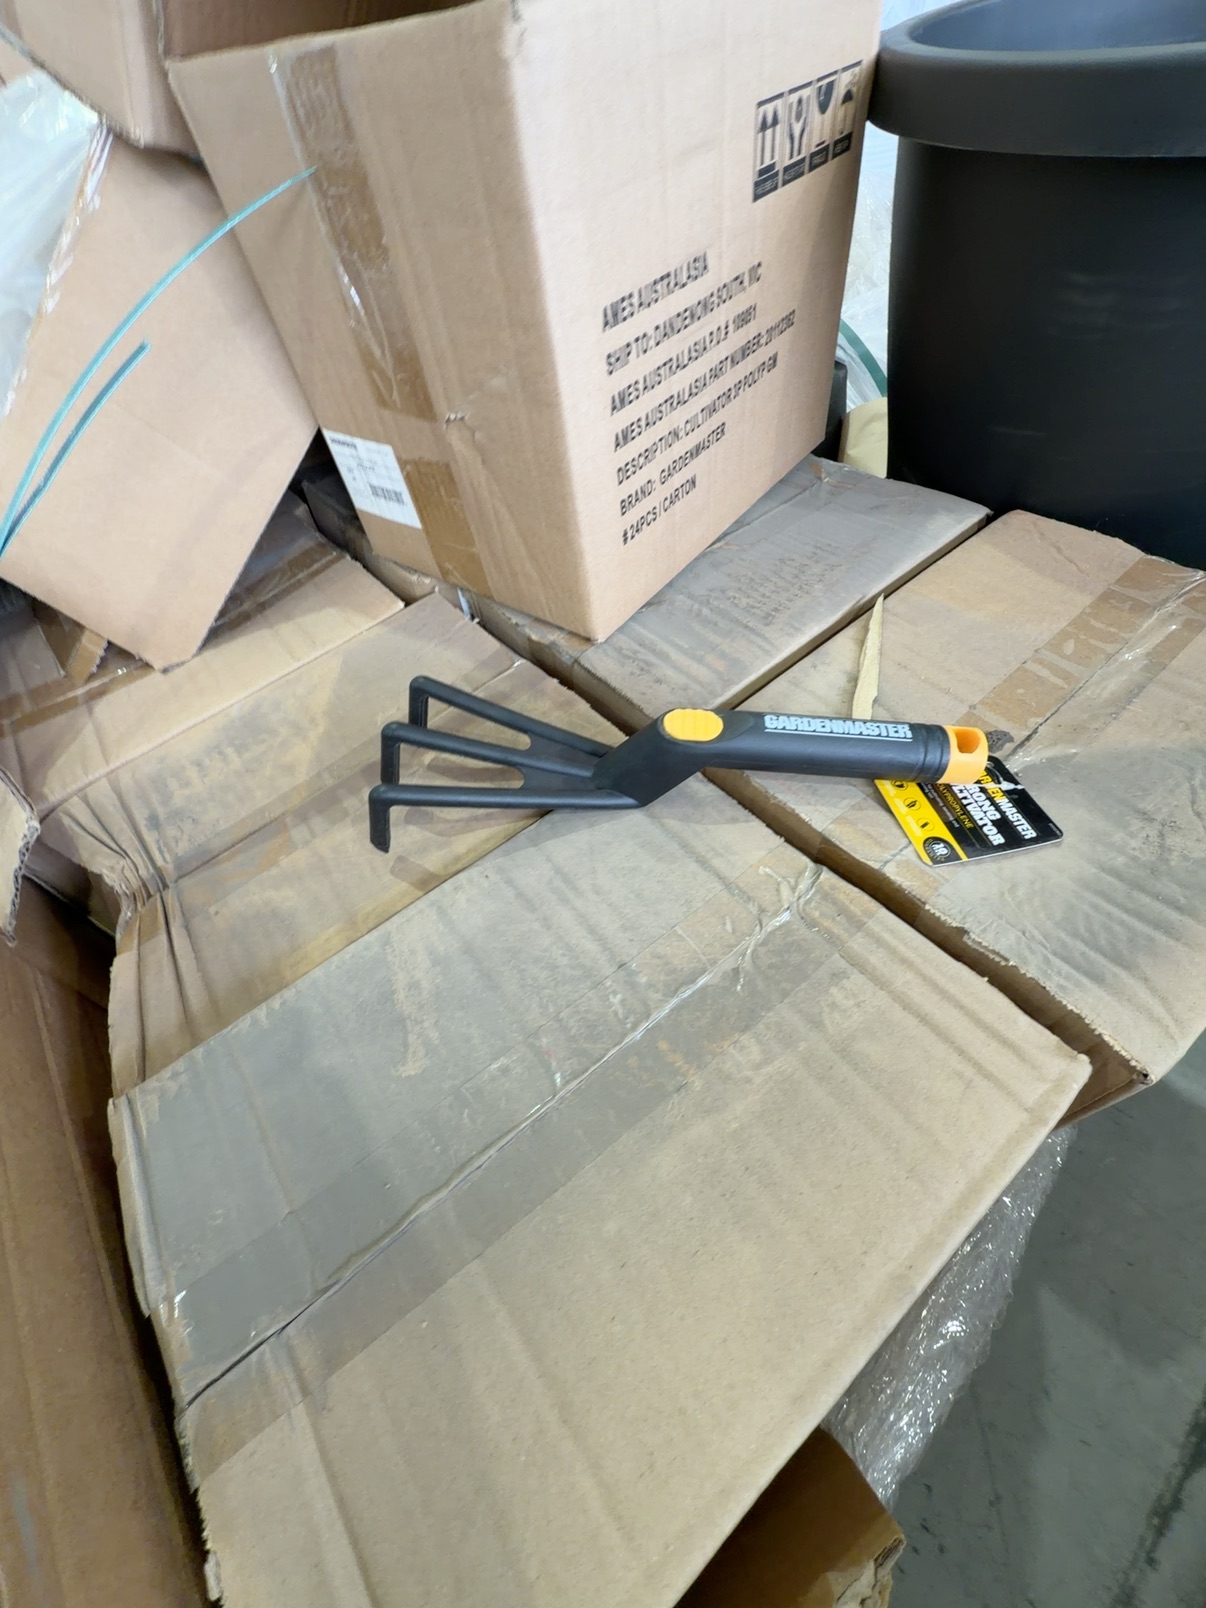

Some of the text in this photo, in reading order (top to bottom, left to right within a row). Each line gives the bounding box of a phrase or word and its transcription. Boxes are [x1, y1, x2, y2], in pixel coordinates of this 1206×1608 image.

[602, 251, 709, 333] AMES AUSTRALASIA
[606, 340, 632, 376] SHIP
[634, 331, 653, 359] TO:
[611, 379, 640, 417] AMES
[642, 335, 708, 397] AUSTRALASIA
[614, 417, 642, 453] AMES
[644, 372, 708, 432] AUSTRALASIA
[708, 355, 730, 387] PART
[729, 332, 764, 371] NUMBER:
[616, 425, 684, 486] DESCRIPTION:
[684, 387, 732, 437] CULTIVATOR
[620, 421, 727, 517] BRAND: GARDENMASTER
[662, 473, 698, 514] CARTON
[764, 714, 913, 739] GARDENMASTER
[936, 783, 975, 829] OLYPROPYLENE
[978, 769, 1037, 840] ARENMASTER
